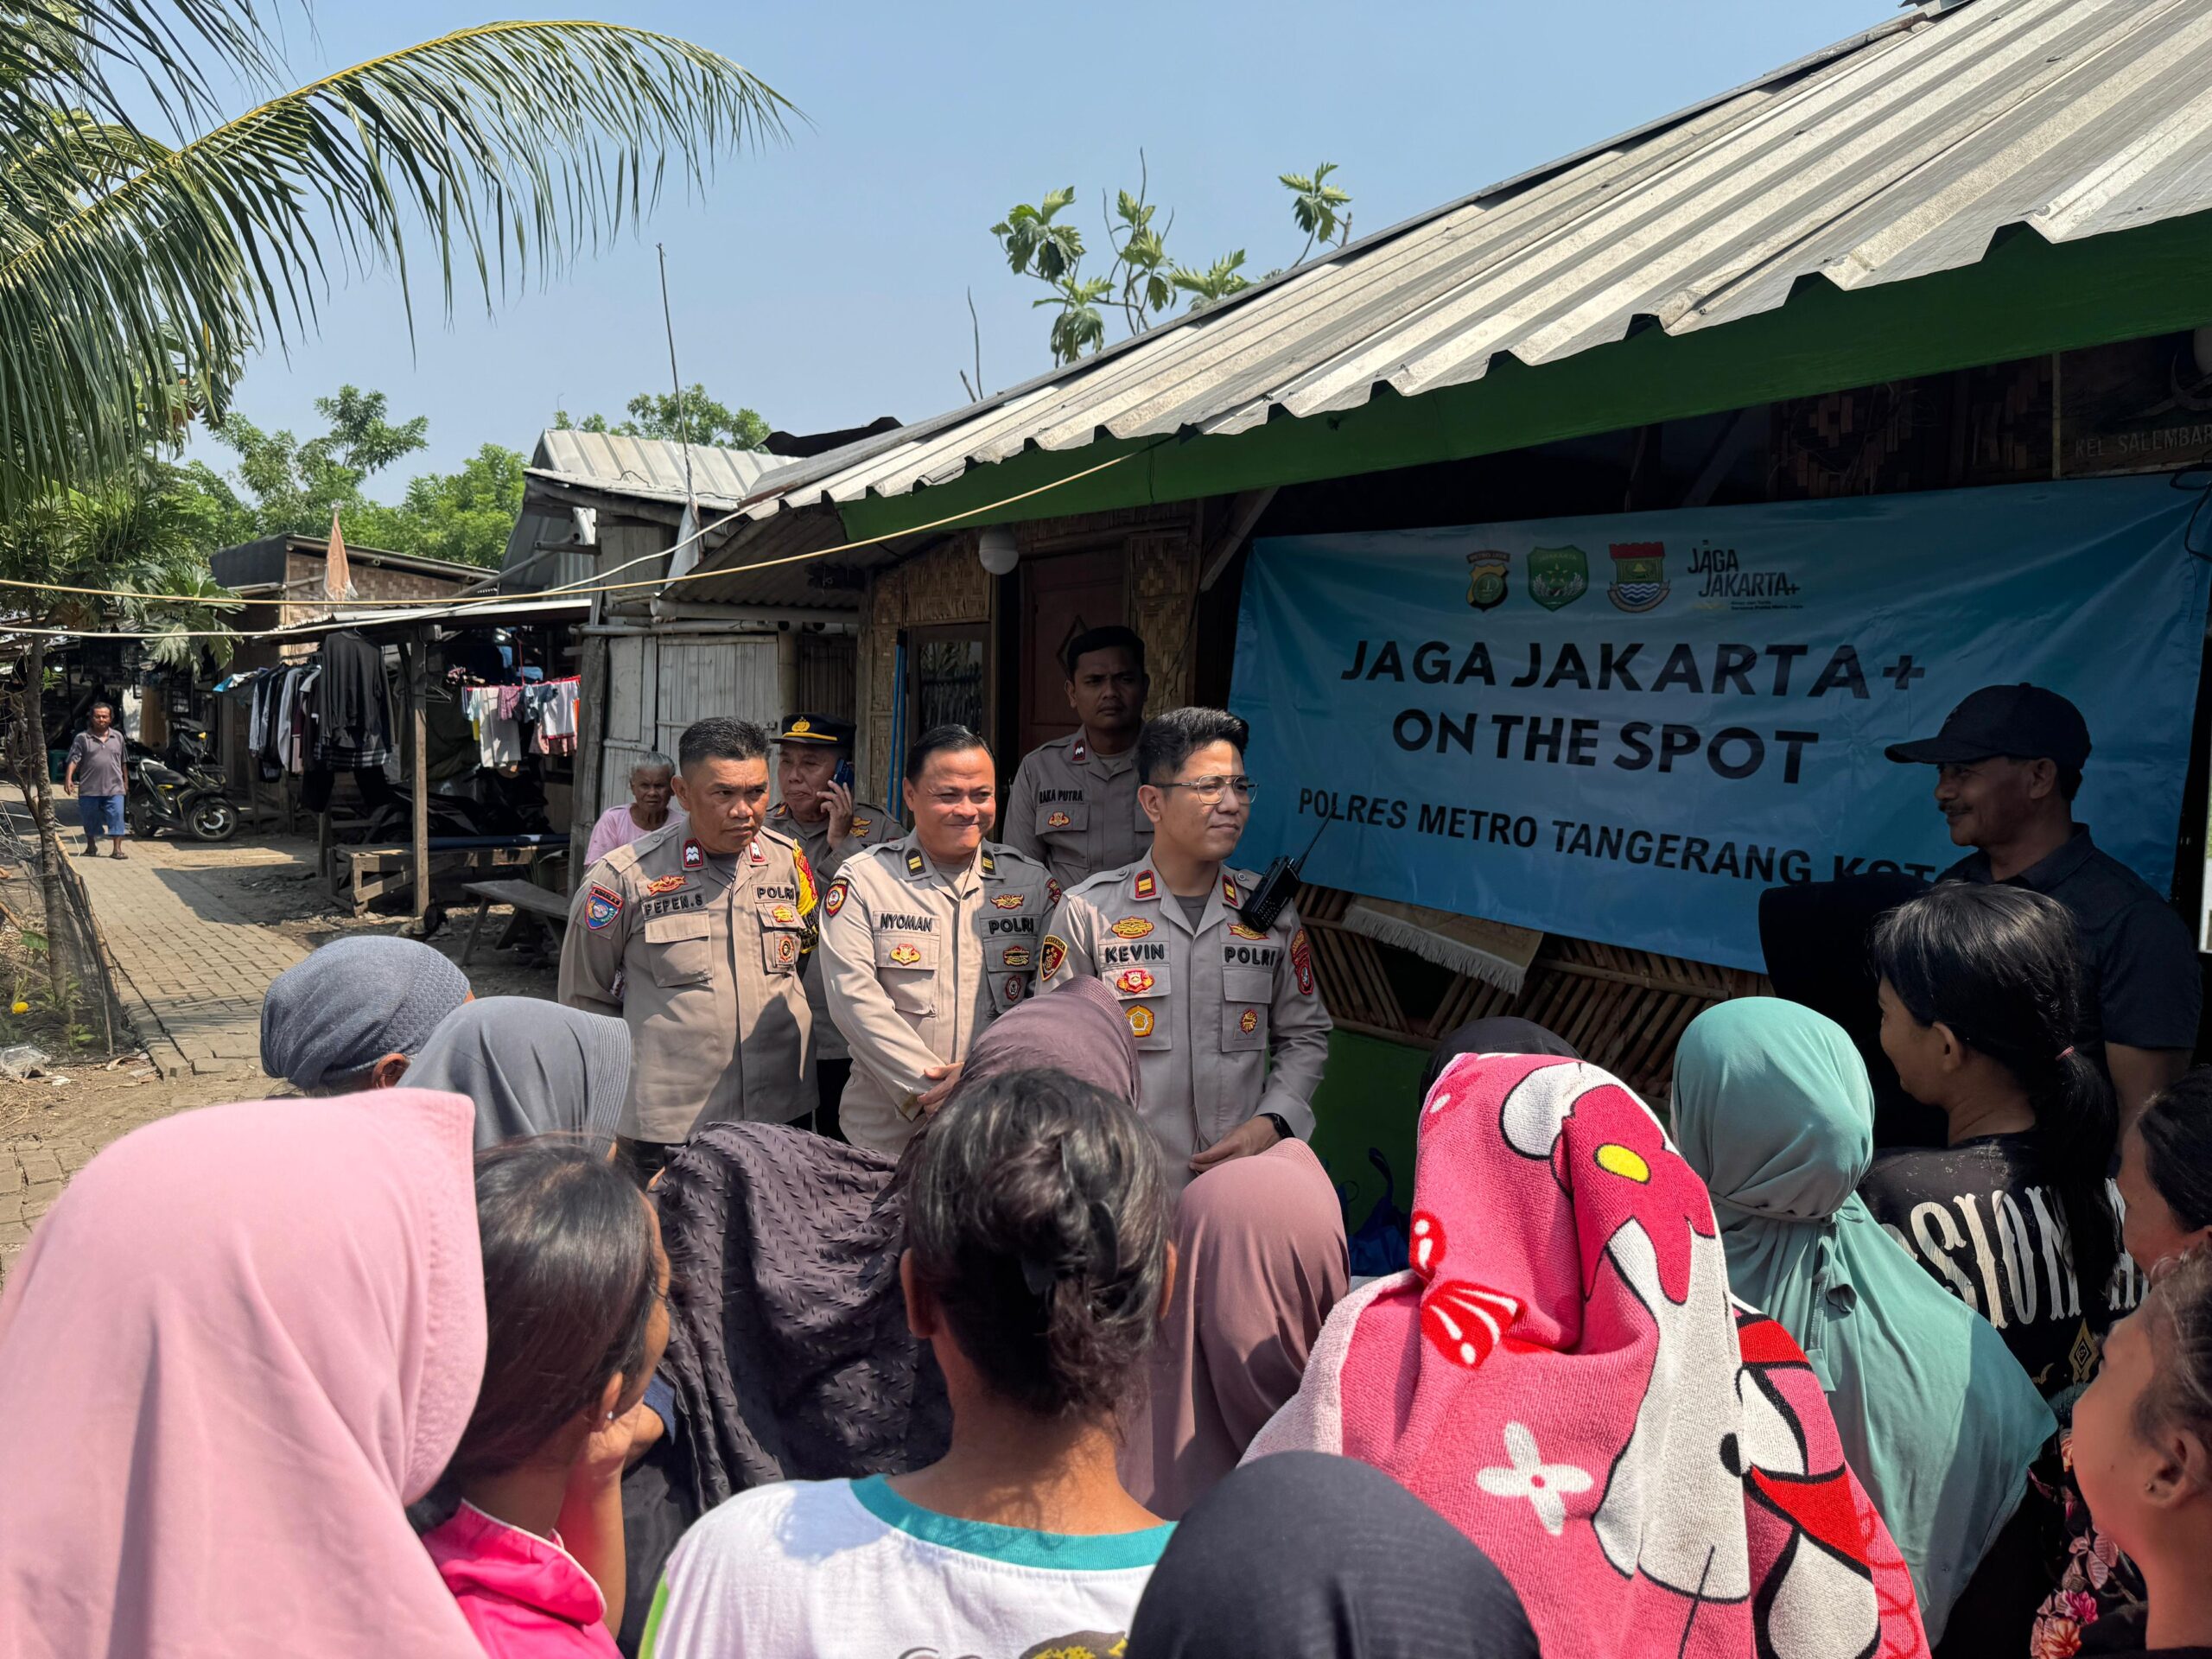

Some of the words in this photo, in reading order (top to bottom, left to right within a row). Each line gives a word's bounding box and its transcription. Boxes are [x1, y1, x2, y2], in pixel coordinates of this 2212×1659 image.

[1688, 547, 1739, 574] JAGA
[1340, 640, 1496, 685] JAGA
[1393, 709, 1478, 755] ON
[1491, 715, 1600, 766] THE
[1613, 721, 1820, 784] SPOT
[1058, 789, 1084, 802] PUTRA
[1298, 787, 1408, 830] POLRES
[1417, 804, 1538, 849] METRO
[1552, 820, 1812, 886] TANGERANG
[757, 887, 795, 900] POLRI
[880, 912, 933, 932] NYOMAN
[988, 918, 1034, 935] POLRI
[1105, 944, 1165, 963] KEVIN
[1224, 946, 1276, 966] POLRI
[1880, 1185, 2082, 1330] SION
